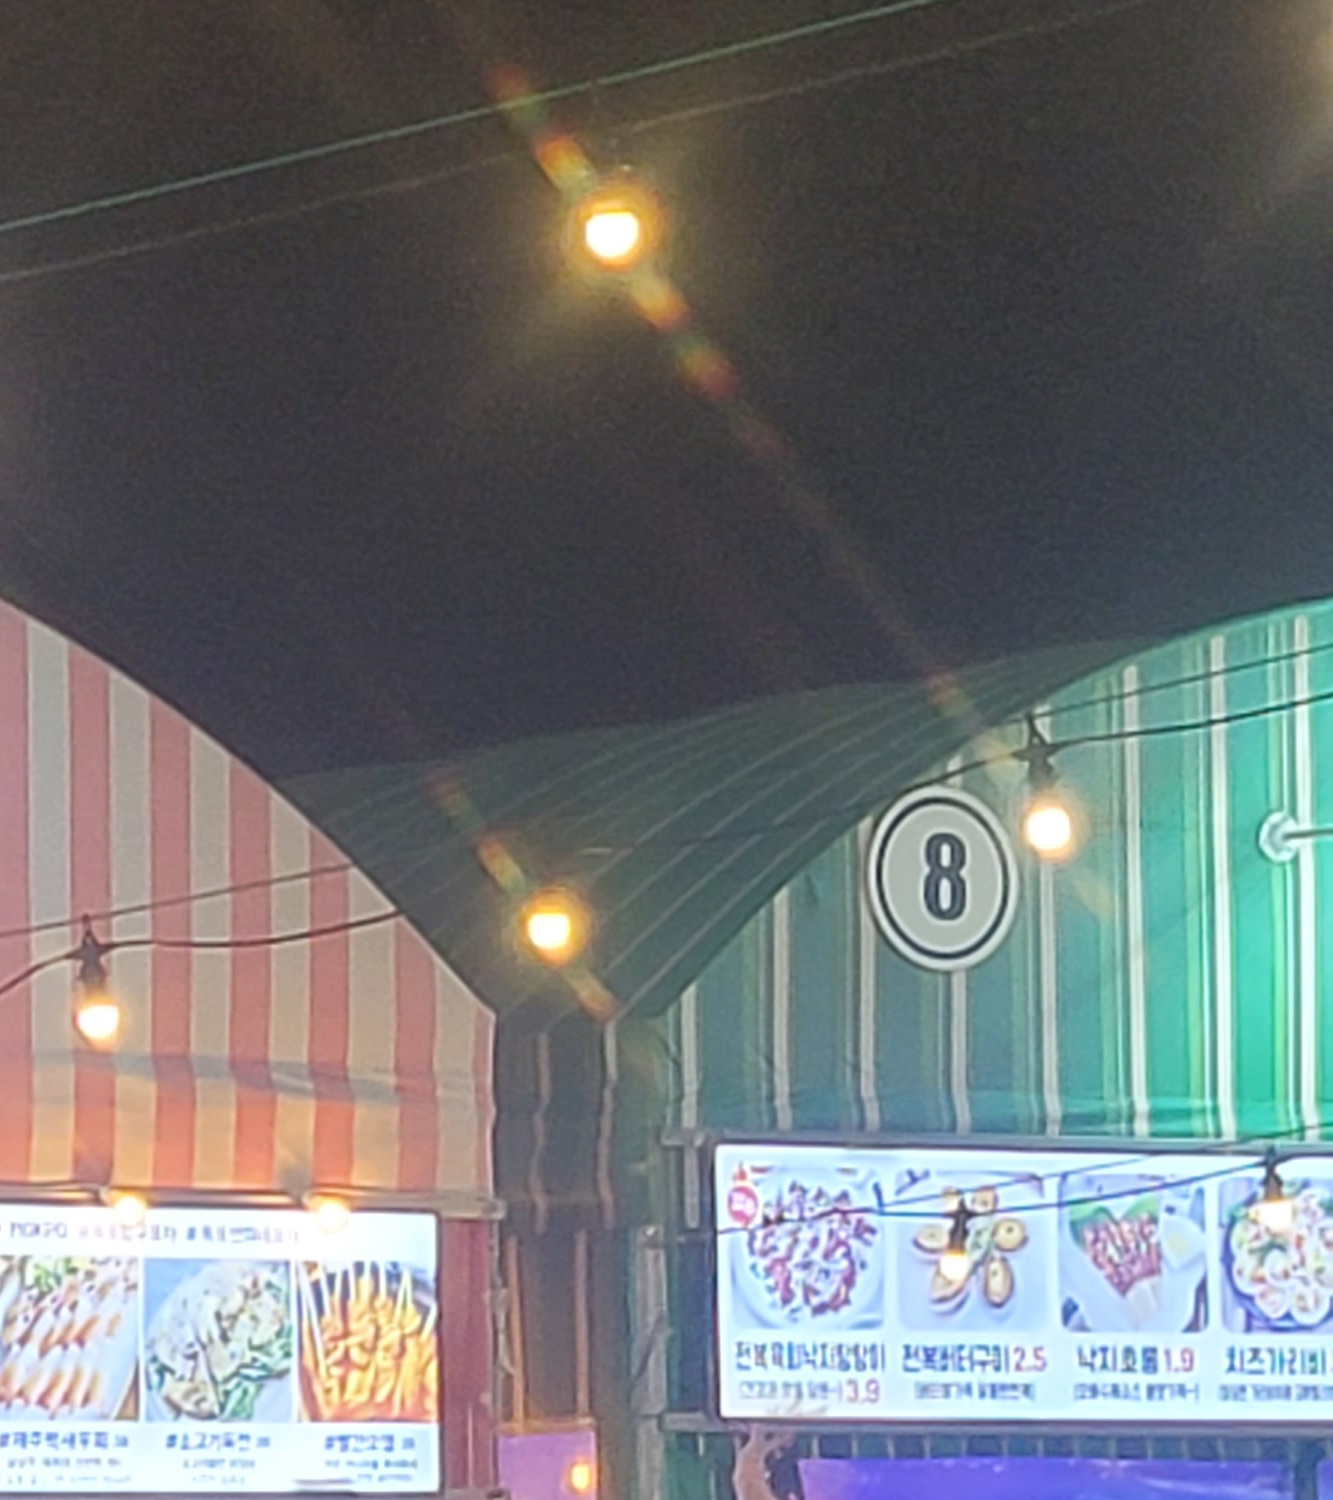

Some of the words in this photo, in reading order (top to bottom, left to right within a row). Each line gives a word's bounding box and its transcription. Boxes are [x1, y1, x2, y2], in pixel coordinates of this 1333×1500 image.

[923, 832, 968, 922] 8
[1012, 1345, 1049, 1374] 2.5
[1163, 1346, 1196, 1374] 1.9
